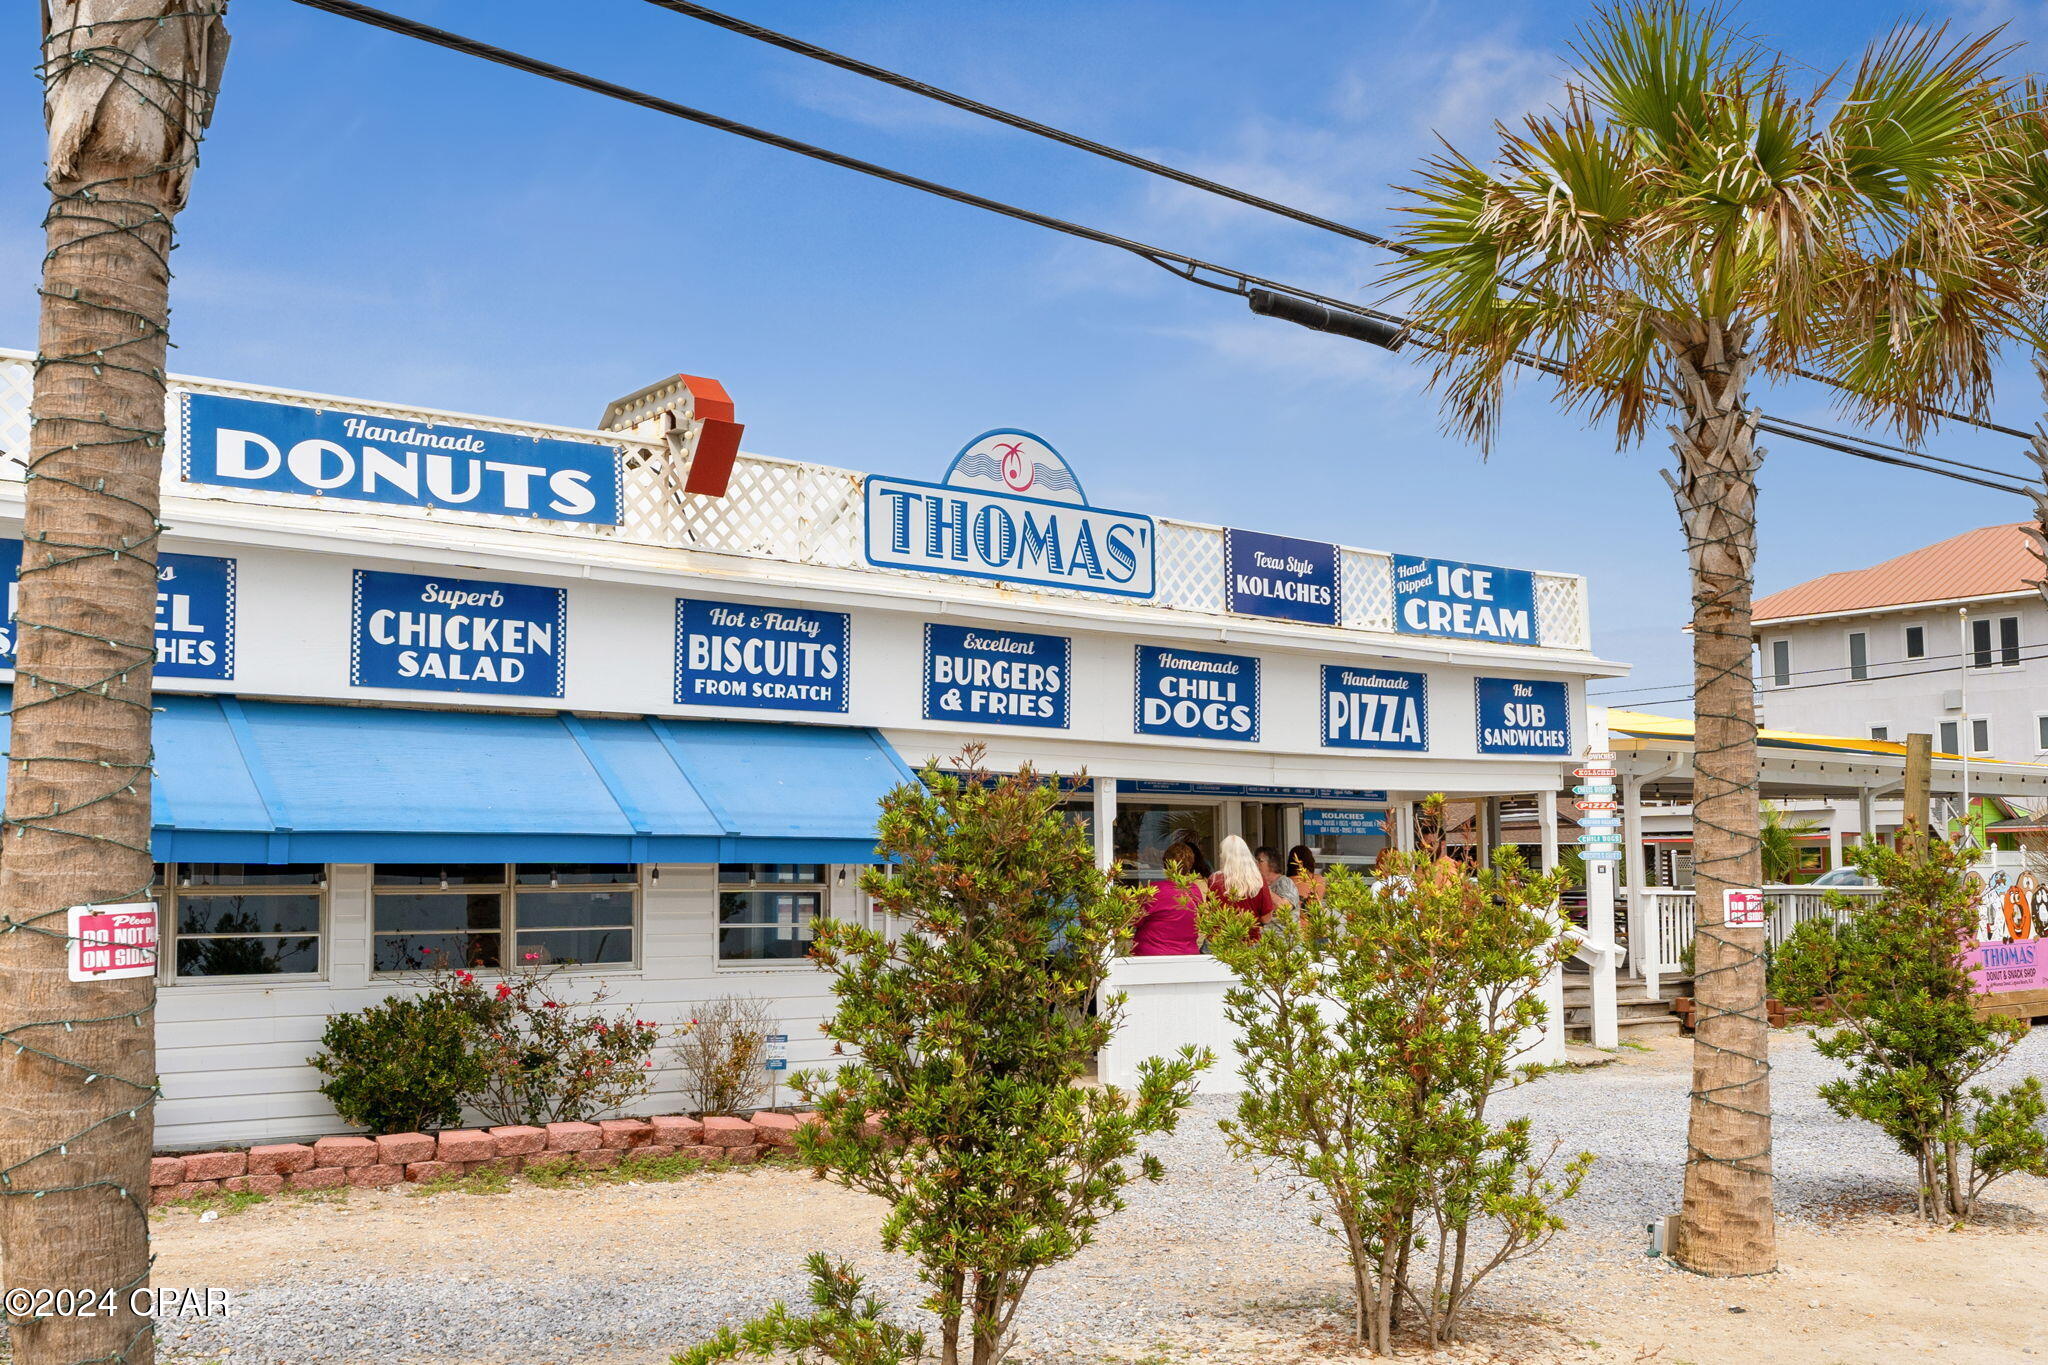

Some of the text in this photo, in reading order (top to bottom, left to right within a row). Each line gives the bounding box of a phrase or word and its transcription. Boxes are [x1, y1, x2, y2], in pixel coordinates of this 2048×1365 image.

[343, 417, 486, 454] Handmade
[216, 428, 596, 515] DONUTS
[880, 488, 1146, 584] THOMAS'
[1254, 551, 1314, 578] Texas Style
[1397, 560, 1427, 579] Hand
[421, 583, 505, 609] Superb
[1236, 574, 1331, 606] KOLACHES
[1396, 573, 1434, 596] Dipped
[1437, 565, 1494, 601] ICE
[368, 608, 553, 656] CHICKEN
[709, 608, 820, 639] Hot & Flaky
[1403, 597, 1530, 640] CREAM
[689, 634, 838, 681] BISCUITS
[963, 632, 1036, 656] Excellent
[398, 650, 526, 684] SALAD
[935, 655, 1061, 693] BURGERS
[1158, 652, 1240, 676] Homemade
[694, 678, 832, 702] FROM SCRATCH
[1159, 675, 1237, 703] CHILI
[1341, 671, 1410, 691] Handmade
[1513, 683, 1534, 699] Hot
[940, 688, 1055, 719] & FRIES
[1144, 697, 1252, 733] DOGS
[1503, 702, 1546, 728] SUB
[1328, 691, 1422, 744] PIZZA
[1484, 727, 1566, 749] SANDWICHES
[1321, 812, 1365, 820] KOLACHES
[83, 929, 110, 948] DO
[114, 926, 144, 945] NOT
[82, 949, 110, 968] ON
[1982, 945, 2036, 967] THOMAS'
[1986, 971, 2003, 982] DONUT
[2008, 969, 2023, 980] SNACK
[2024, 968, 2036, 977] SHOP
